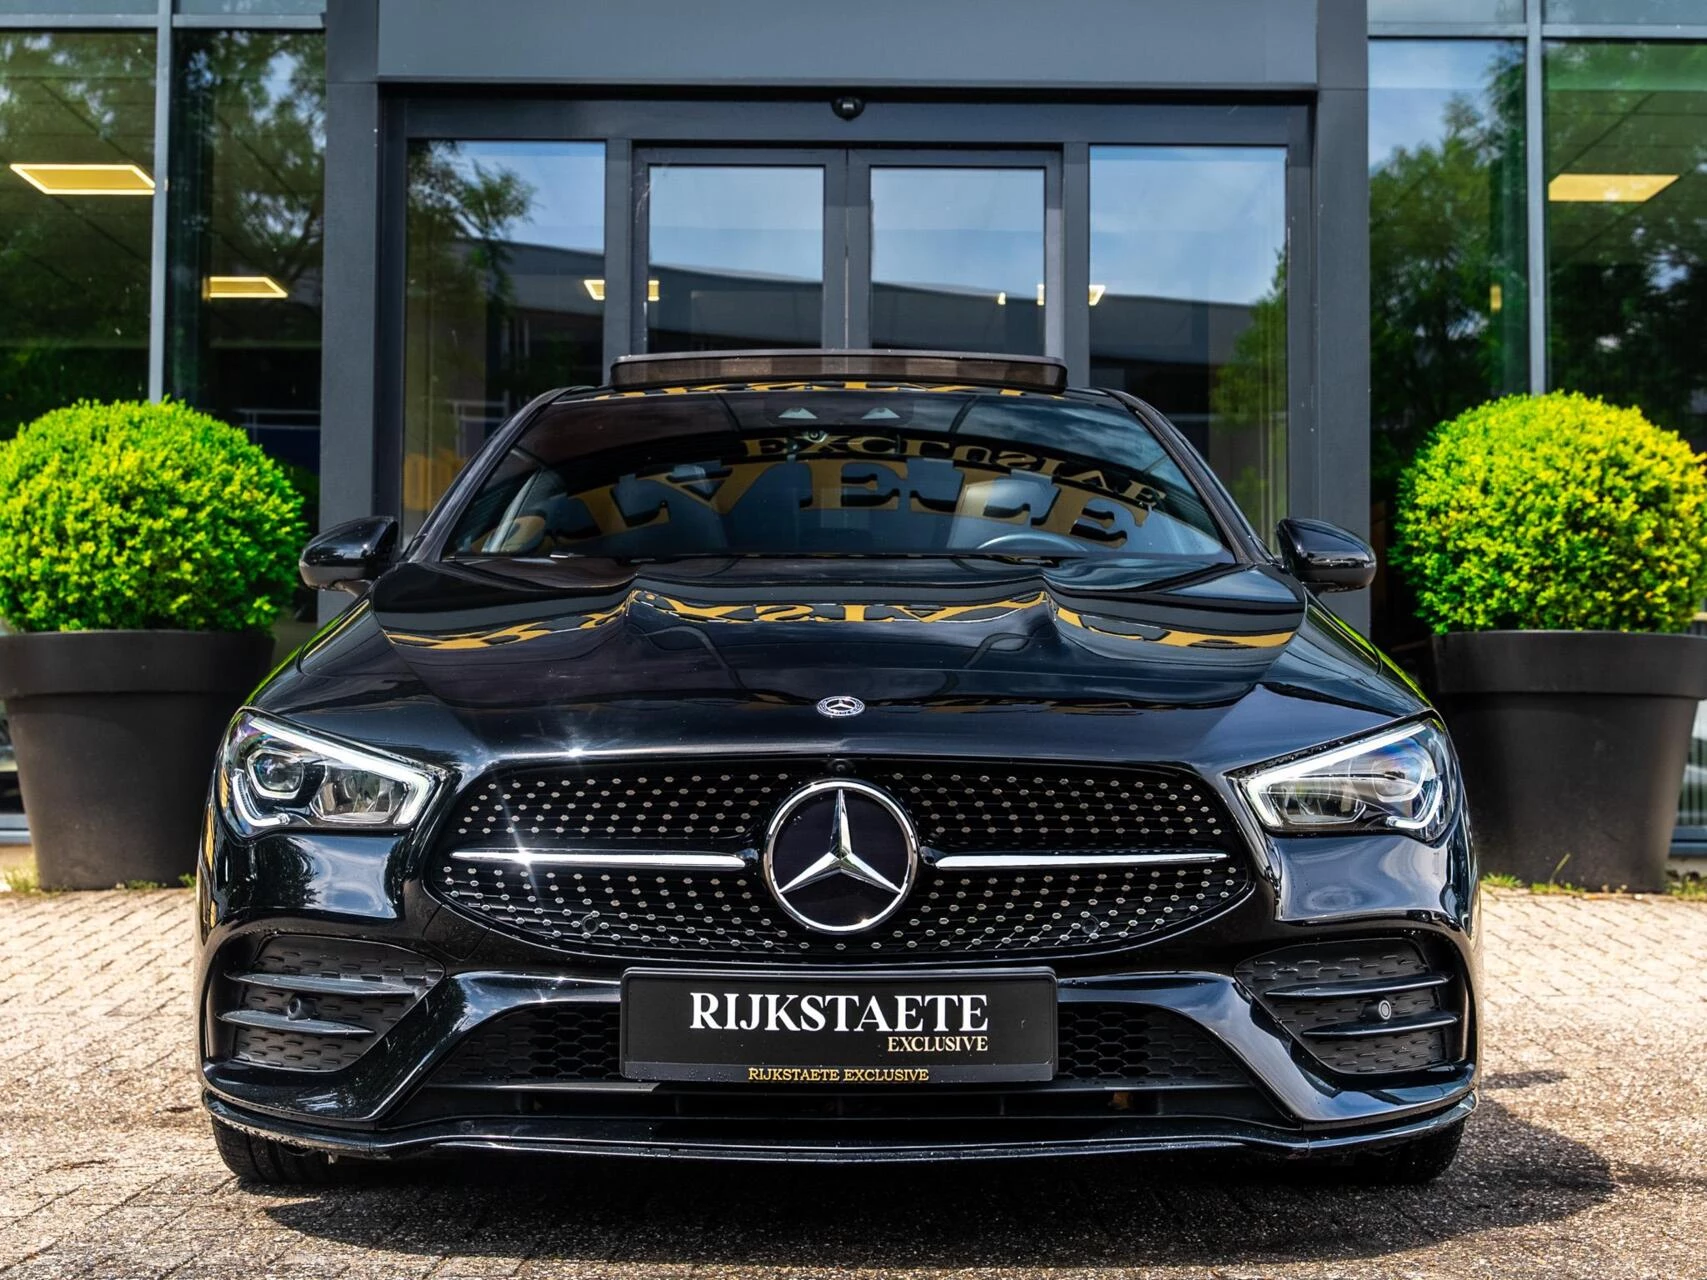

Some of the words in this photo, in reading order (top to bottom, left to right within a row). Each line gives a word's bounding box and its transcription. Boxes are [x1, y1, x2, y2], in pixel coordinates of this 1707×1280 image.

[689, 992, 989, 1032] RIJKSTAETE
[887, 1036, 989, 1053] EXCLUSIVE
[748, 1067, 840, 1082] RIJKSTAETE
[843, 1068, 930, 1082] EXCLUSIVE
